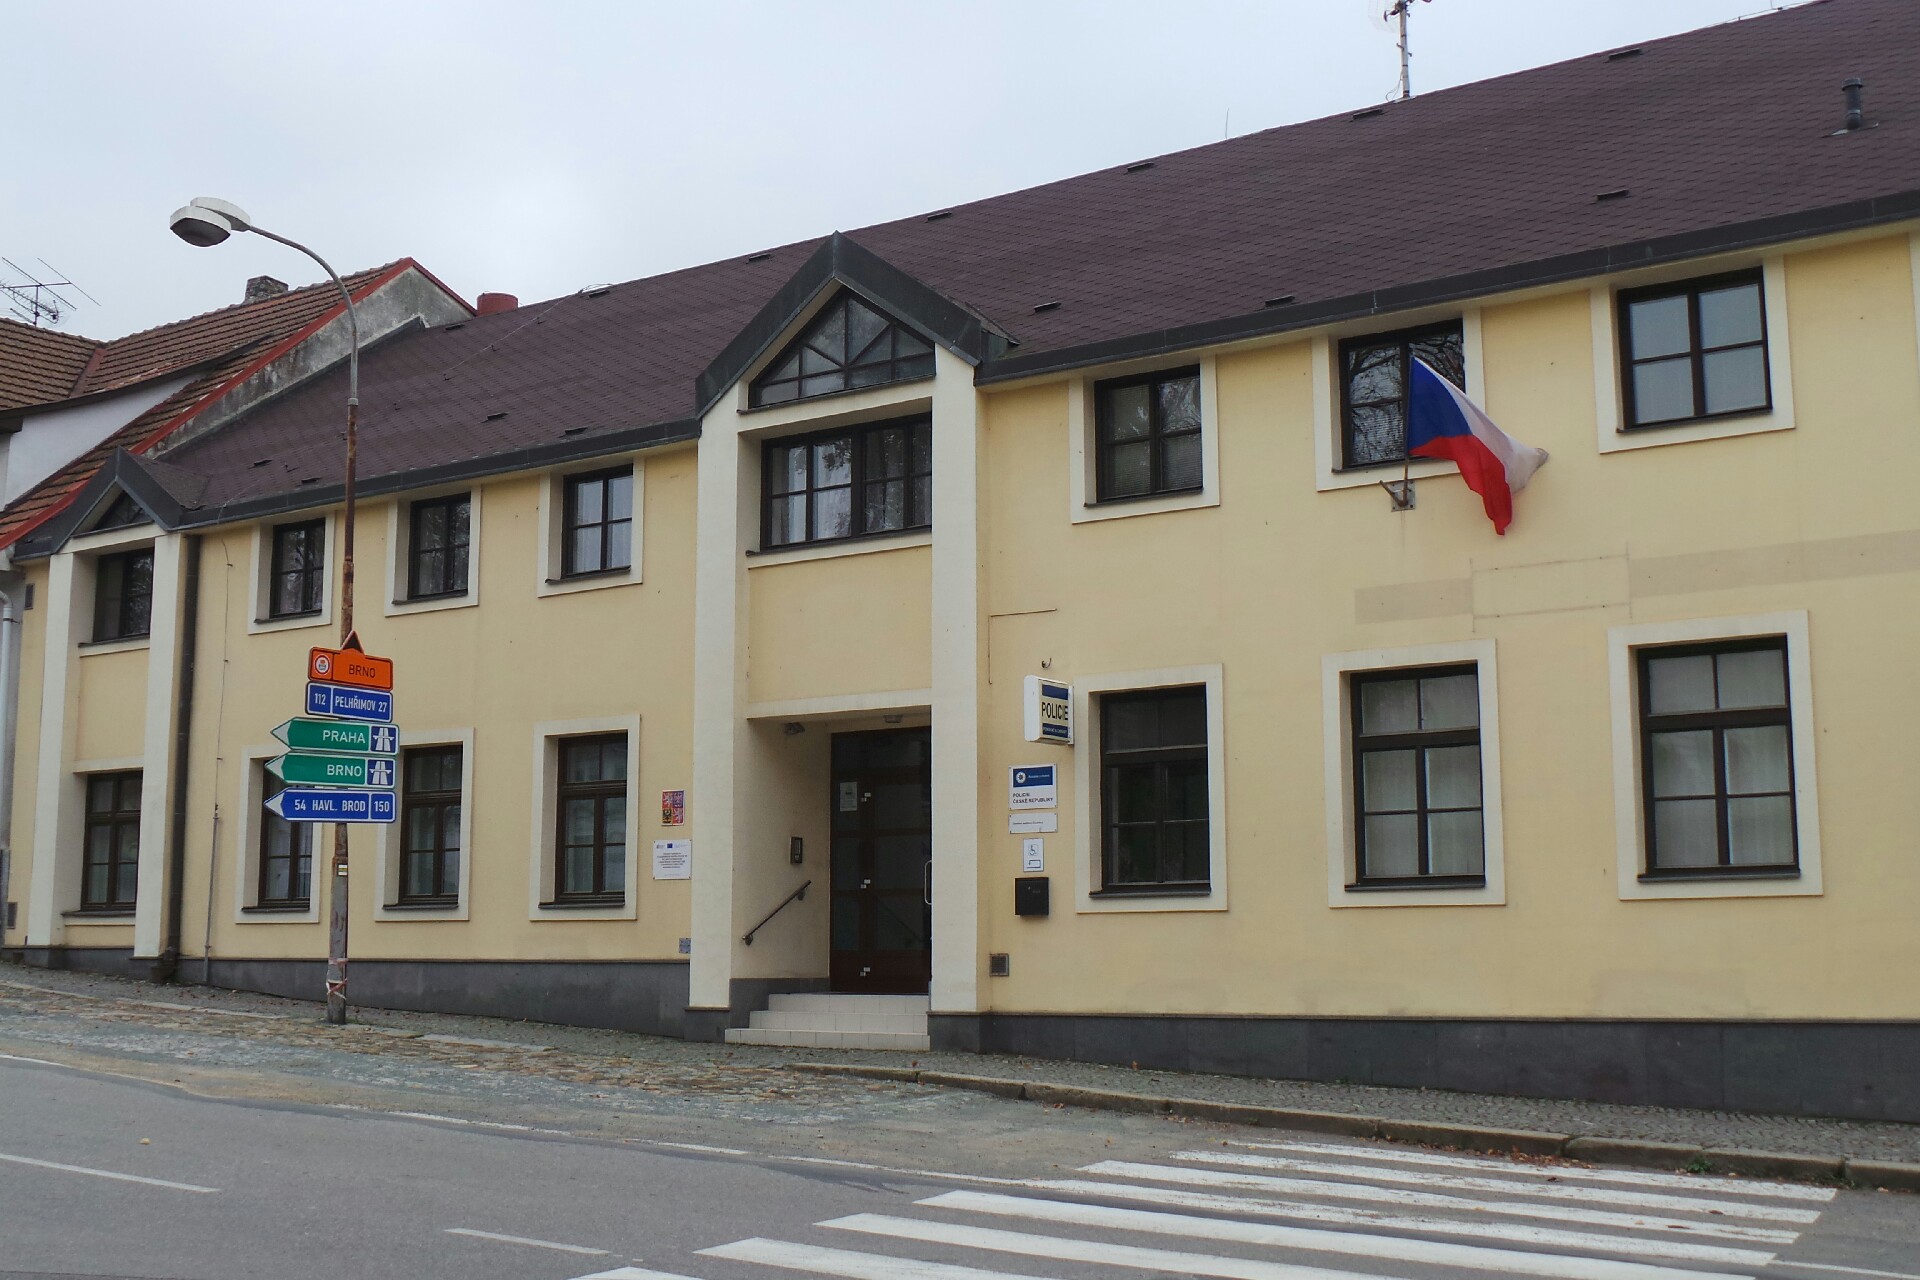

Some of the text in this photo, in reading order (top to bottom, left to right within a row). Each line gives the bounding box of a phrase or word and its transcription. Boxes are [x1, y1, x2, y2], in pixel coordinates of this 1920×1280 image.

[349, 664, 376, 678] BRNO
[314, 693, 388, 713] 112 PELHŘIMOV 27
[1041, 701, 1069, 721] POLICIE
[322, 730, 366, 744] PRAHA
[327, 765, 362, 777] BRNO
[294, 799, 390, 813] 54 HAVL. BROD 150
